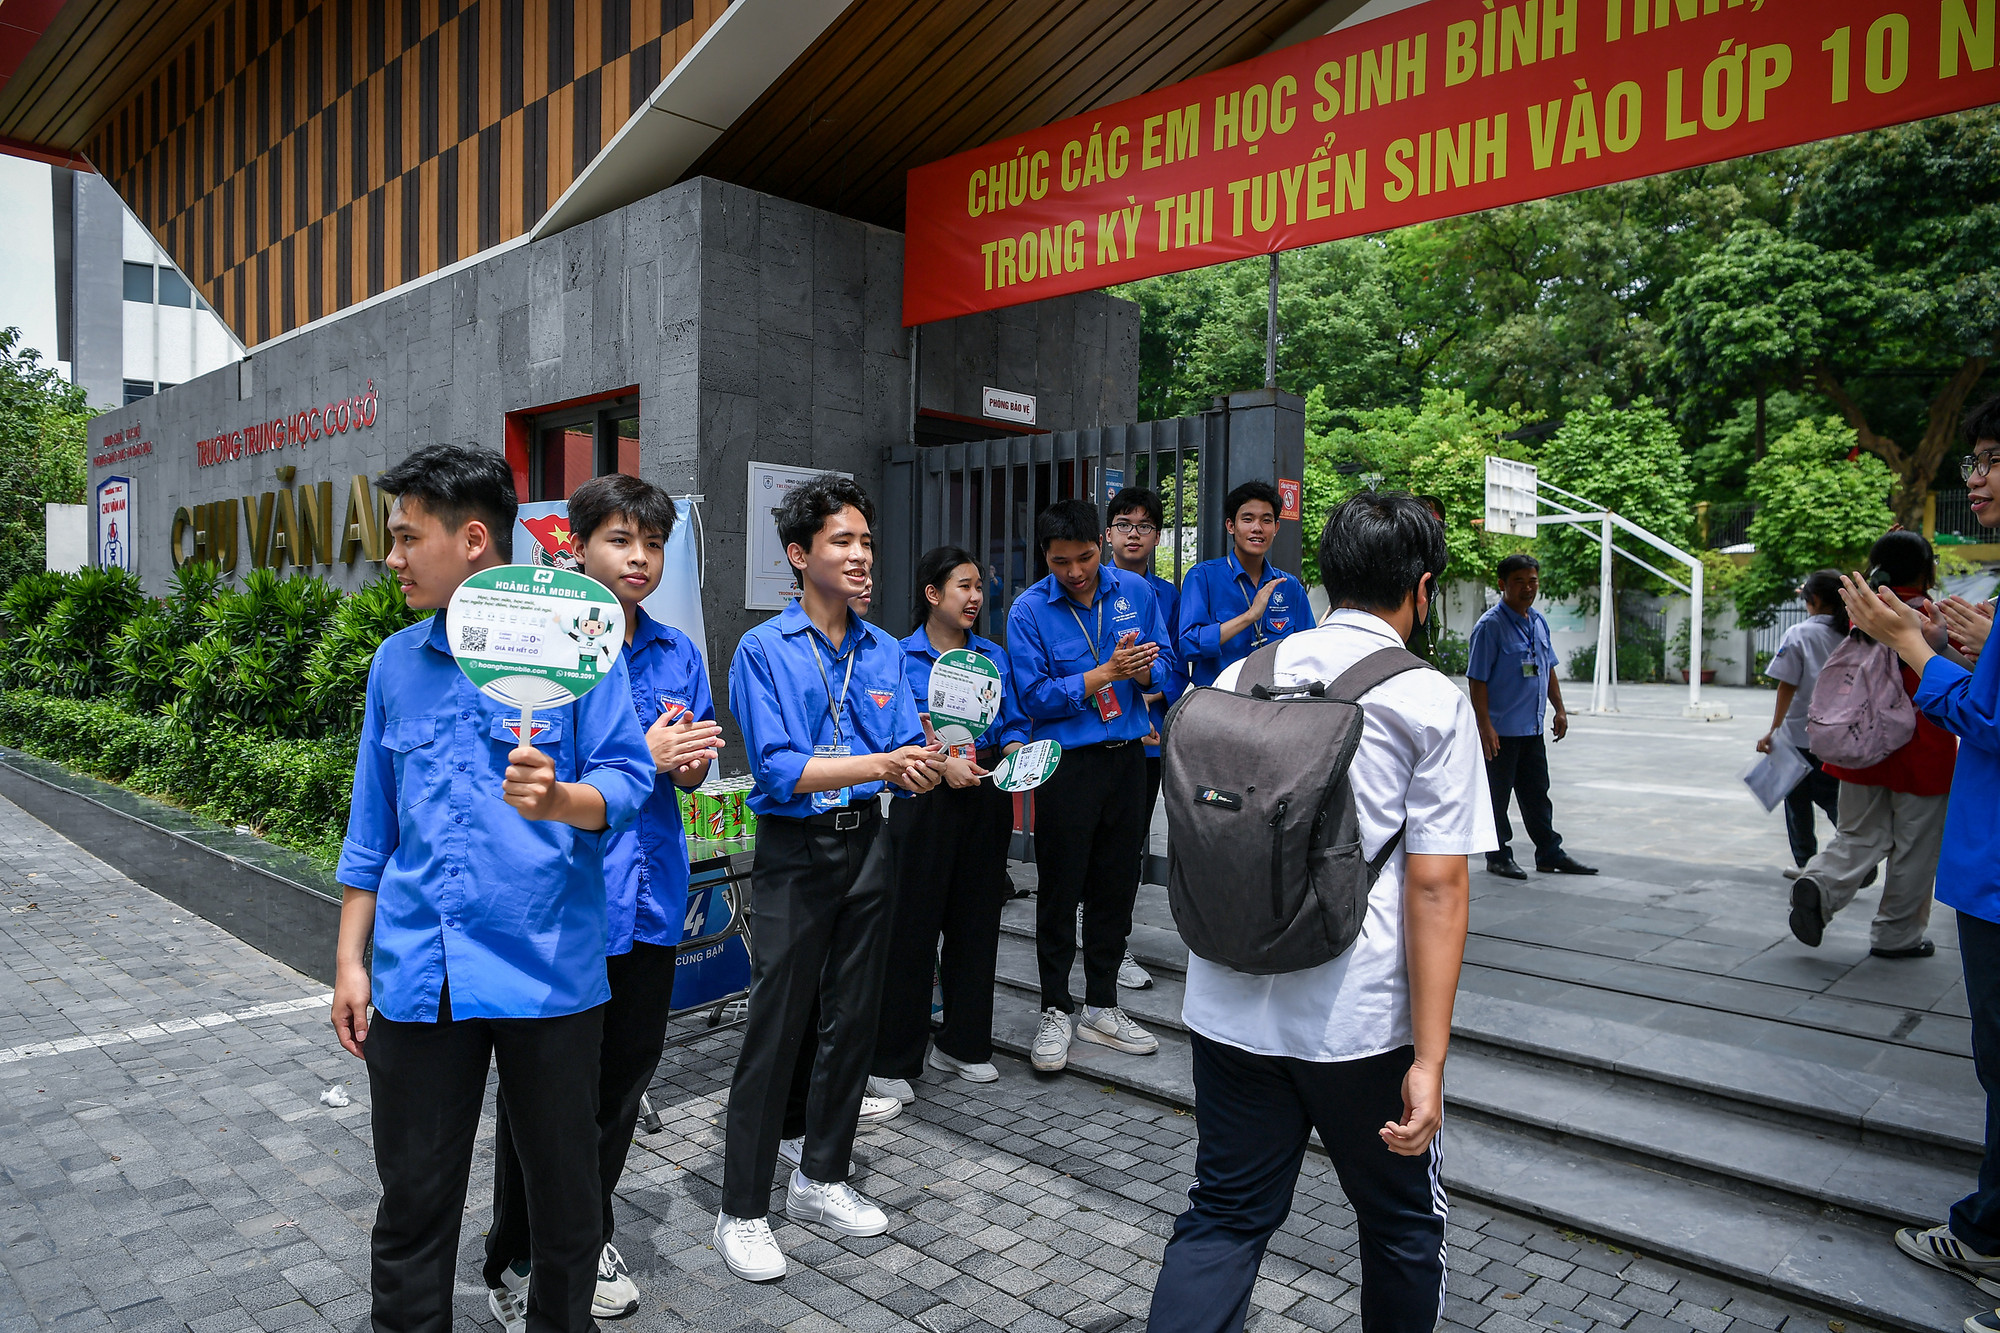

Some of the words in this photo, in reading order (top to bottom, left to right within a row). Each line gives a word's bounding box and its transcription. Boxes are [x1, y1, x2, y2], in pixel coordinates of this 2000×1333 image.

[967, 146, 1050, 219] CHÚC
[1060, 122, 1130, 193] CÁC
[1141, 103, 1201, 171] EM
[1213, 75, 1297, 155] HỌC
[1311, 33, 1428, 124] SINH
[1445, 0, 1578, 87] BÌNH
[981, 219, 1085, 291] TRONG
[1096, 196, 1143, 266] KỲ
[1154, 187, 1215, 252] THI
[1228, 131, 1368, 238] TUYỂN
[1384, 113, 1508, 203] SINH
[1527, 78, 1642, 170] VÀO
[1665, 37, 1792, 141] LỚP
[1822, 13, 1909, 104] 10
[1939, 0, 2000, 79] N
[243, 418, 286, 457] TRUNG
[288, 407, 321, 450] HỌC
[323, 397, 351, 436] CƠ
[353, 377, 379, 430] SỞ
[171, 498, 239, 575] CHU
[242, 465, 333, 569] VĂN
[495, 580, 530, 593] HOÀNG
[532, 582, 547, 594] HÀ
[549, 587, 587, 599] MOBILE
[478, 661, 548, 675] hoanghamobile.com
[563, 671, 596, 680] 1900.2091
[675, 952, 703, 966] CÙNG
[706, 943, 724, 958] BẠN
